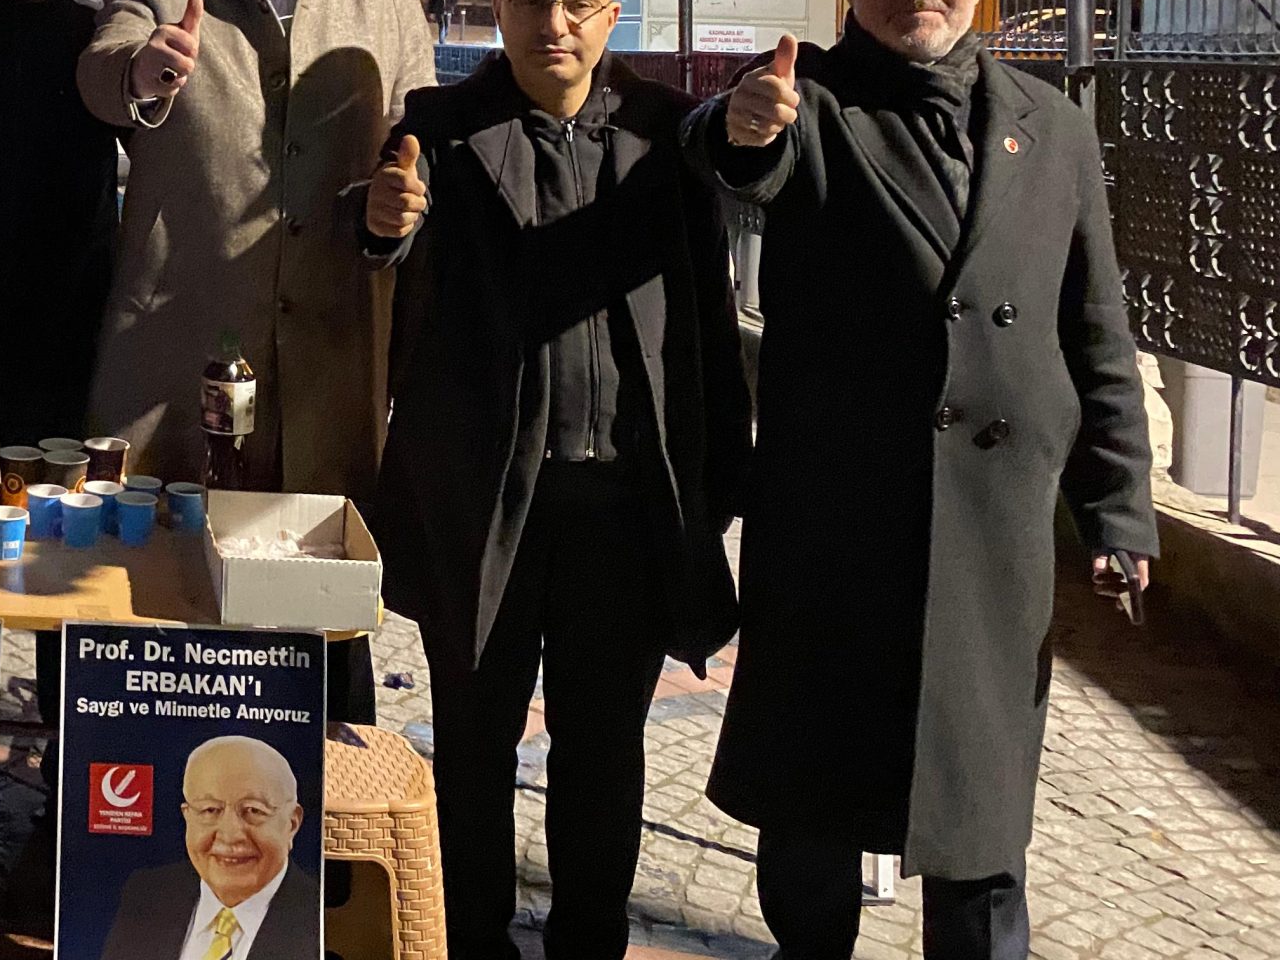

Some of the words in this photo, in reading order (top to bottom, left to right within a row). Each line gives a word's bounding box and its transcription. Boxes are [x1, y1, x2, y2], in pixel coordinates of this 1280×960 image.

[79, 637, 135, 661] Prof.
[144, 640, 176, 663] Dr.
[185, 642, 310, 669] Necmettin
[76, 696, 124, 718] Saygı
[129, 702, 150, 715] ve
[155, 699, 231, 719] Minnetle
[236, 703, 311, 724] Anıyoruz
